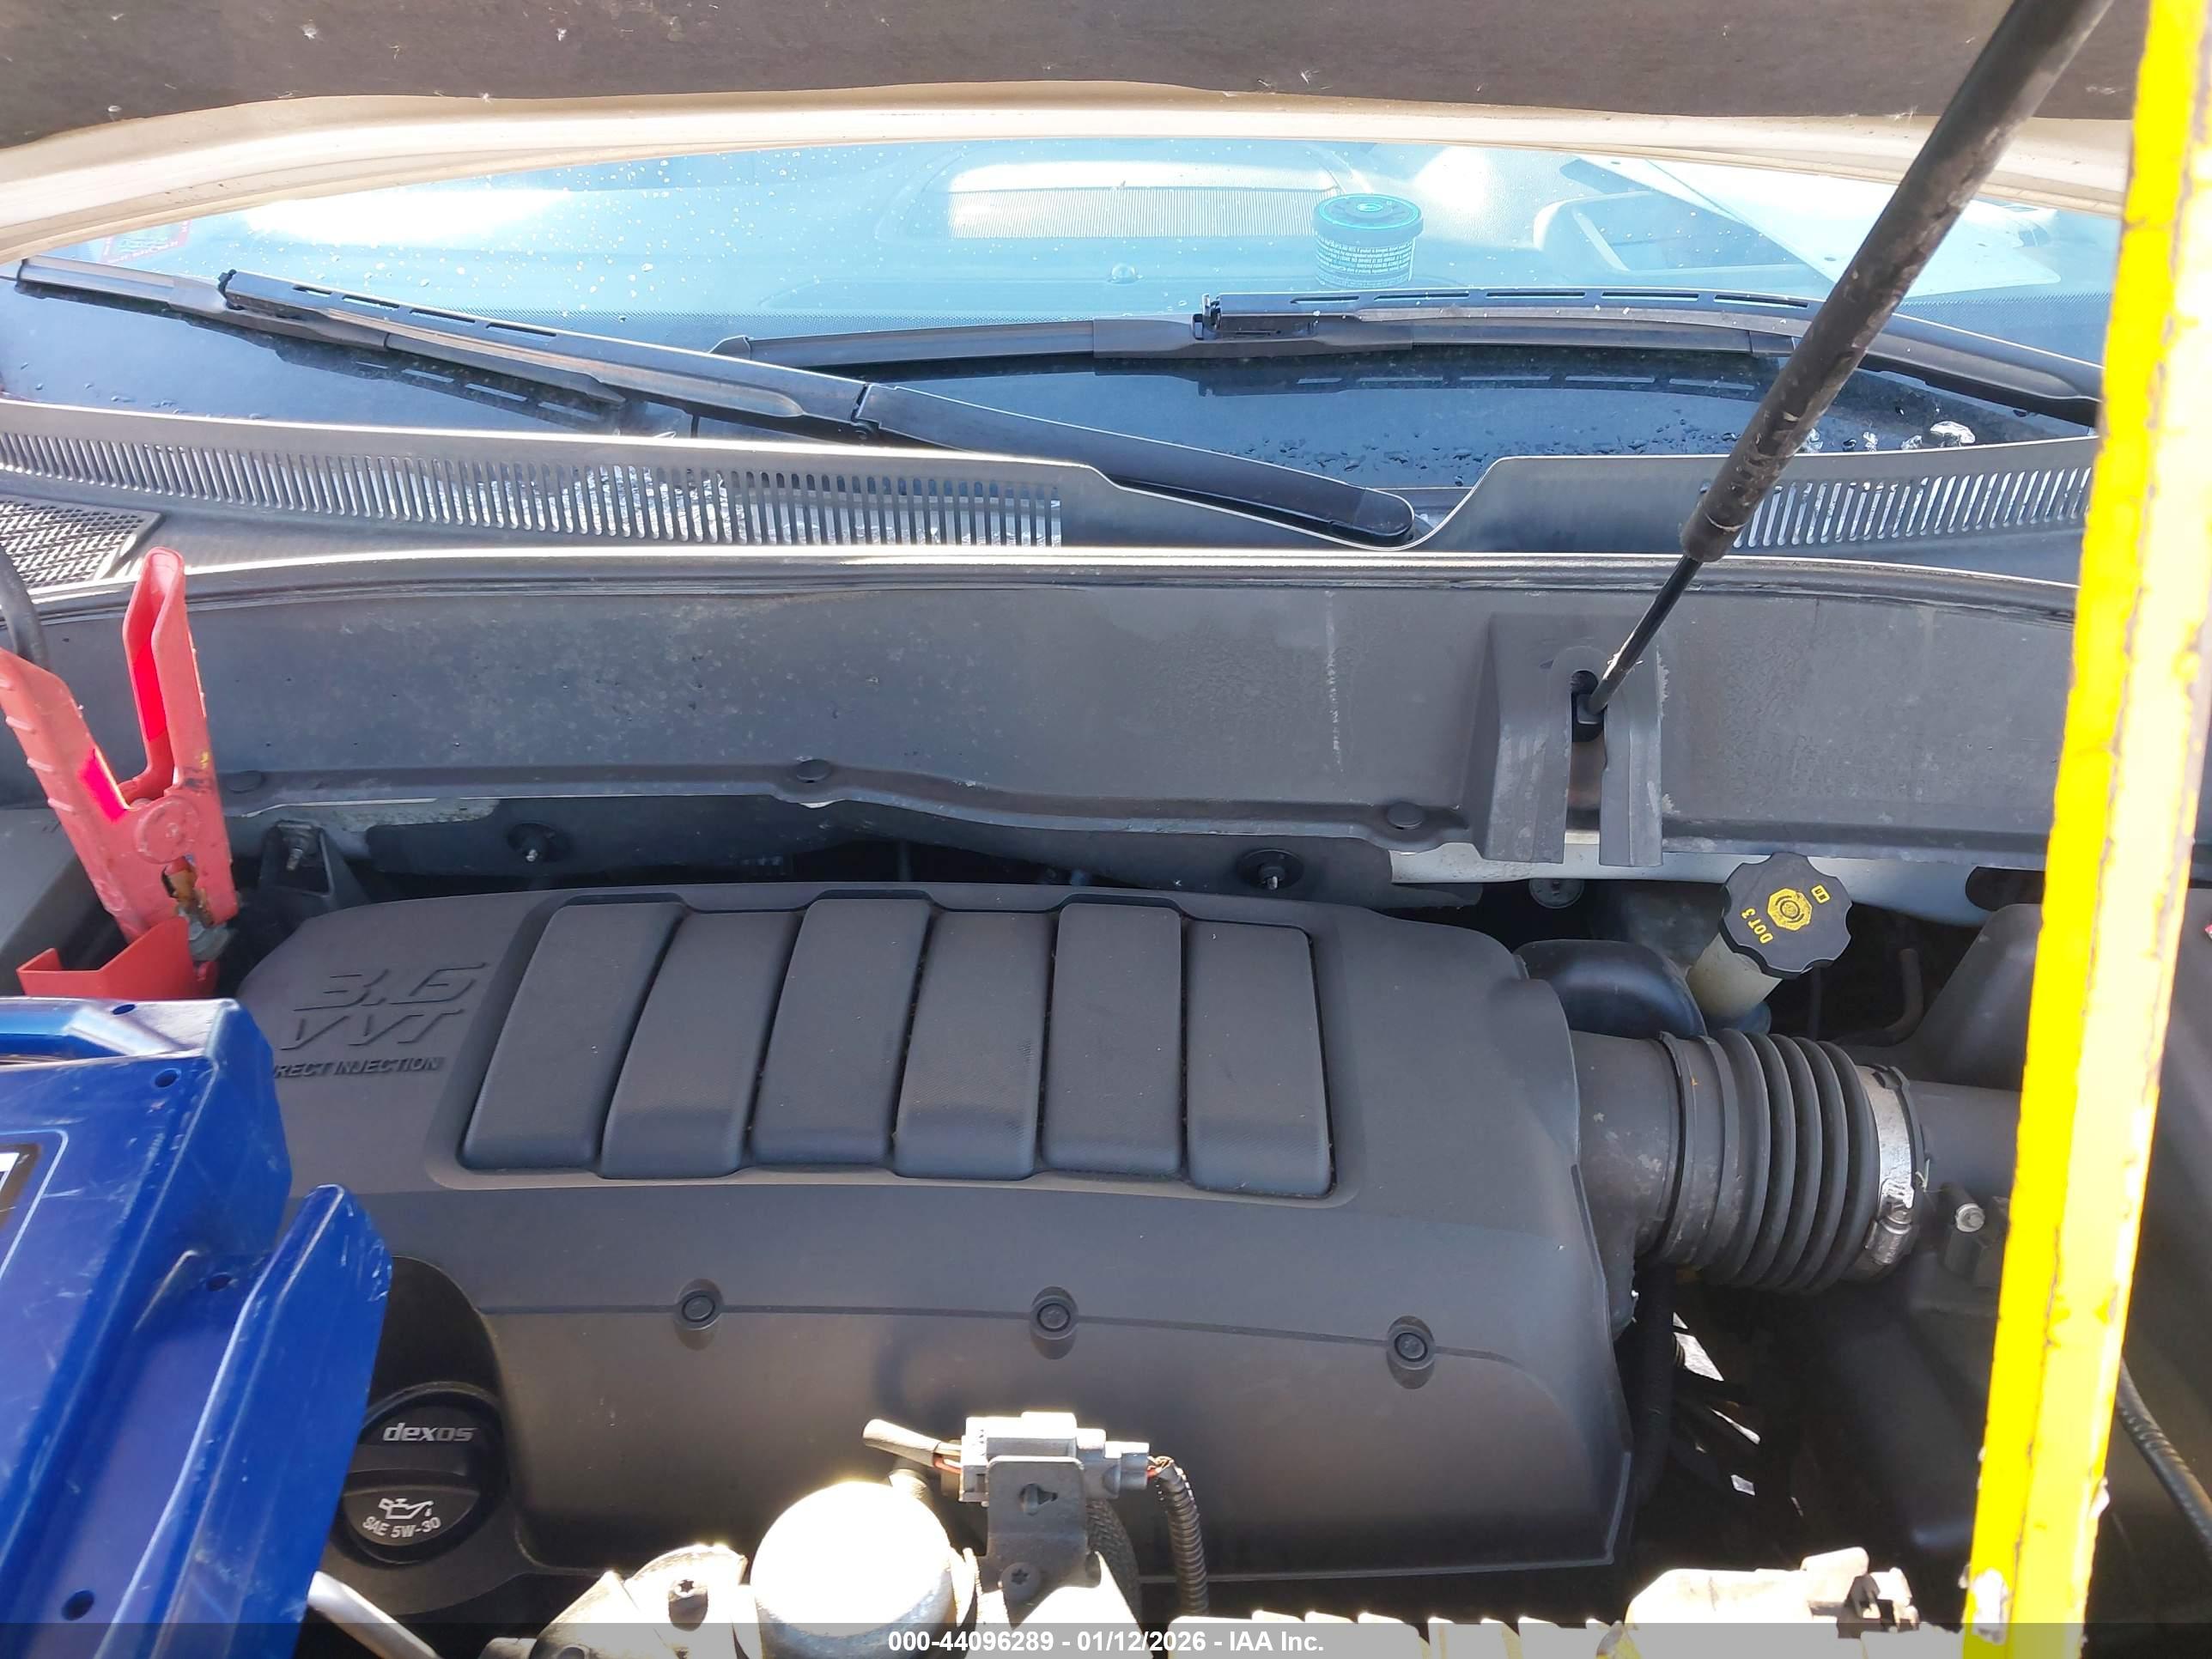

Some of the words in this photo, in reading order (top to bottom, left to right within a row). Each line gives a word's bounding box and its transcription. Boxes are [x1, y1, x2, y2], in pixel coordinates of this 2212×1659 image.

[1740, 907, 1757, 920] 3
[1747, 918, 1774, 944] DOT
[293, 962, 489, 1012] 3.6
[278, 1008, 465, 1052] VVT
[273, 1060, 334, 1079] RECT
[334, 1056, 445, 1075] INJECTION
[383, 1422, 478, 1443] dexos
[362, 1515, 391, 1536] SAE
[390, 1516, 442, 1539] 5W-30
